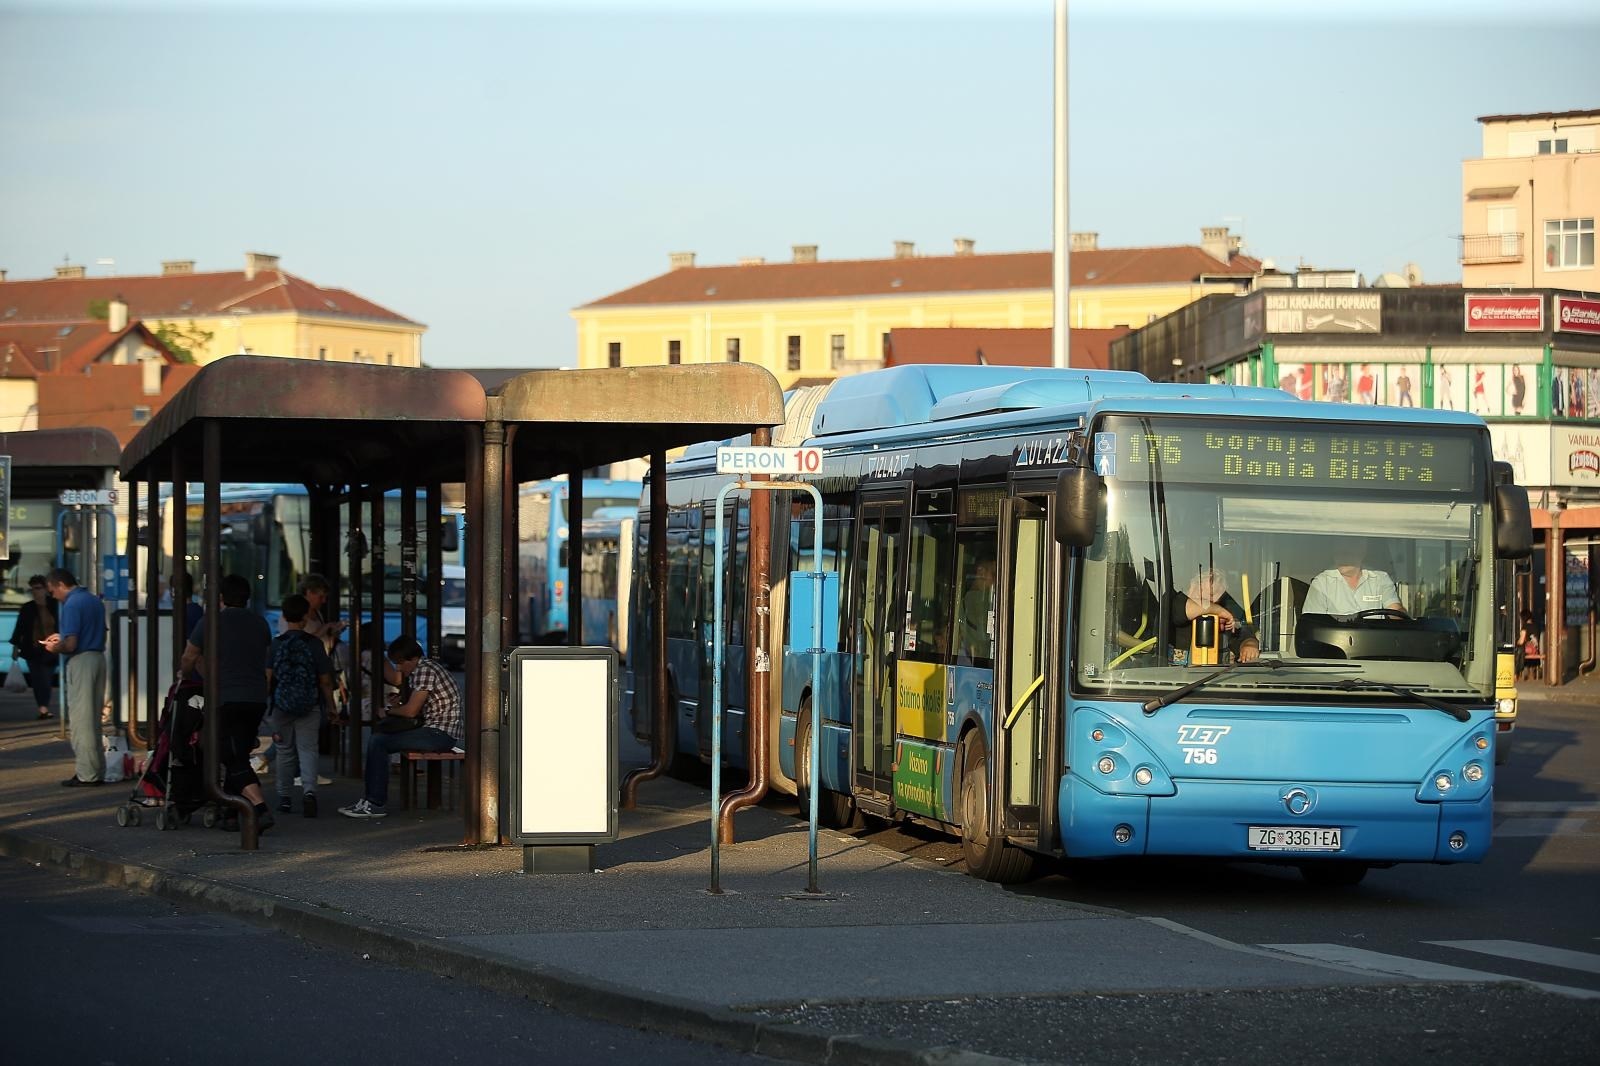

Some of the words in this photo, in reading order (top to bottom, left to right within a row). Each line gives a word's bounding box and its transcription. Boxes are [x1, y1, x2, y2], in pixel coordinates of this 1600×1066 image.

[1267, 294, 1288, 309] BRZI
[1129, 434, 1182, 464] 176
[1568, 433, 1600, 447] VANILLA
[721, 452, 785, 469] PERON
[793, 450, 820, 472] 10
[1029, 438, 1062, 465] ULAZ
[875, 453, 901, 479] IZLAZ
[1329, 458, 1433, 482] Bistra
[62, 493, 97, 503] PERON
[108, 491, 117, 504] 9
[1177, 725, 1232, 745] ZET
[1182, 748, 1218, 765] 756
[1259, 829, 1277, 846] ZG
